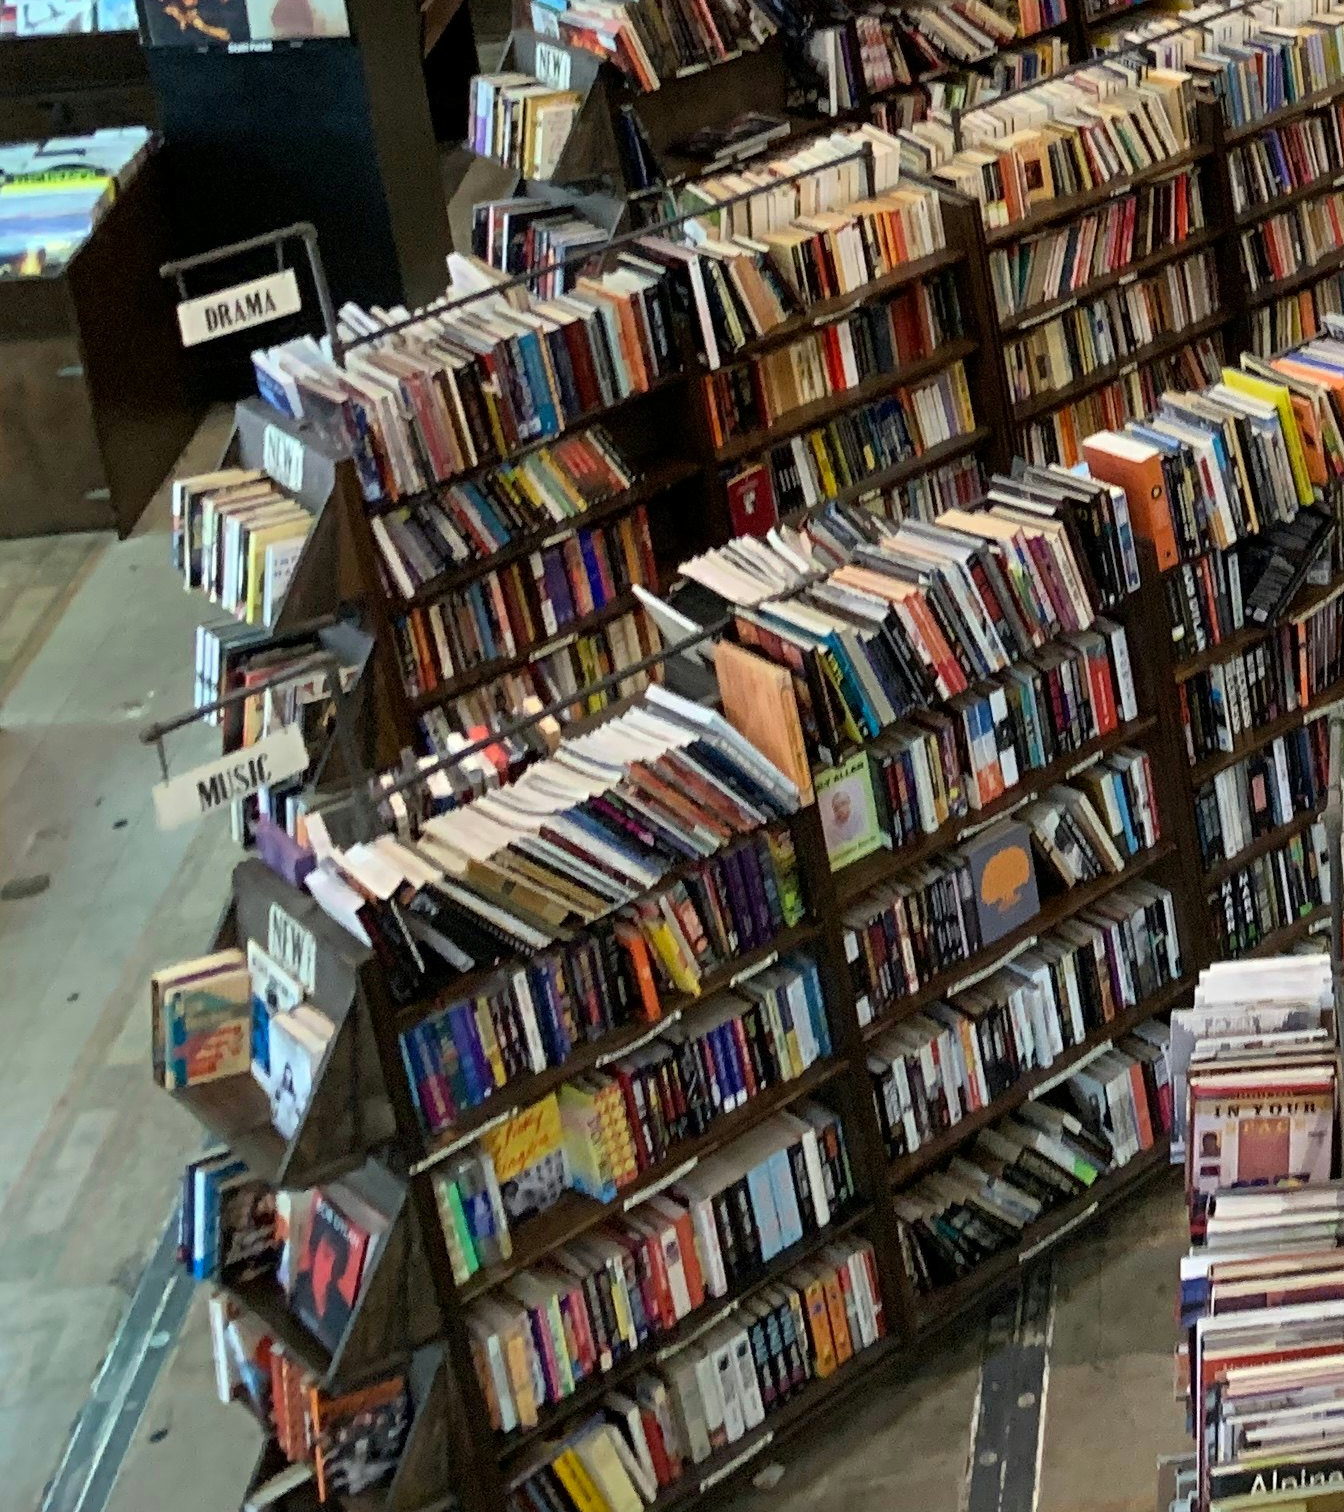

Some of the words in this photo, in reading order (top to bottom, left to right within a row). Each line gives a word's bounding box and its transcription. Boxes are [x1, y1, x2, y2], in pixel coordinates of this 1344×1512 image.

[204, 288, 277, 333] DRAMA
[196, 752, 272, 812] MUSIC
[1214, 1103, 1239, 1118] IN
[1254, 1101, 1317, 1116] YOUR
